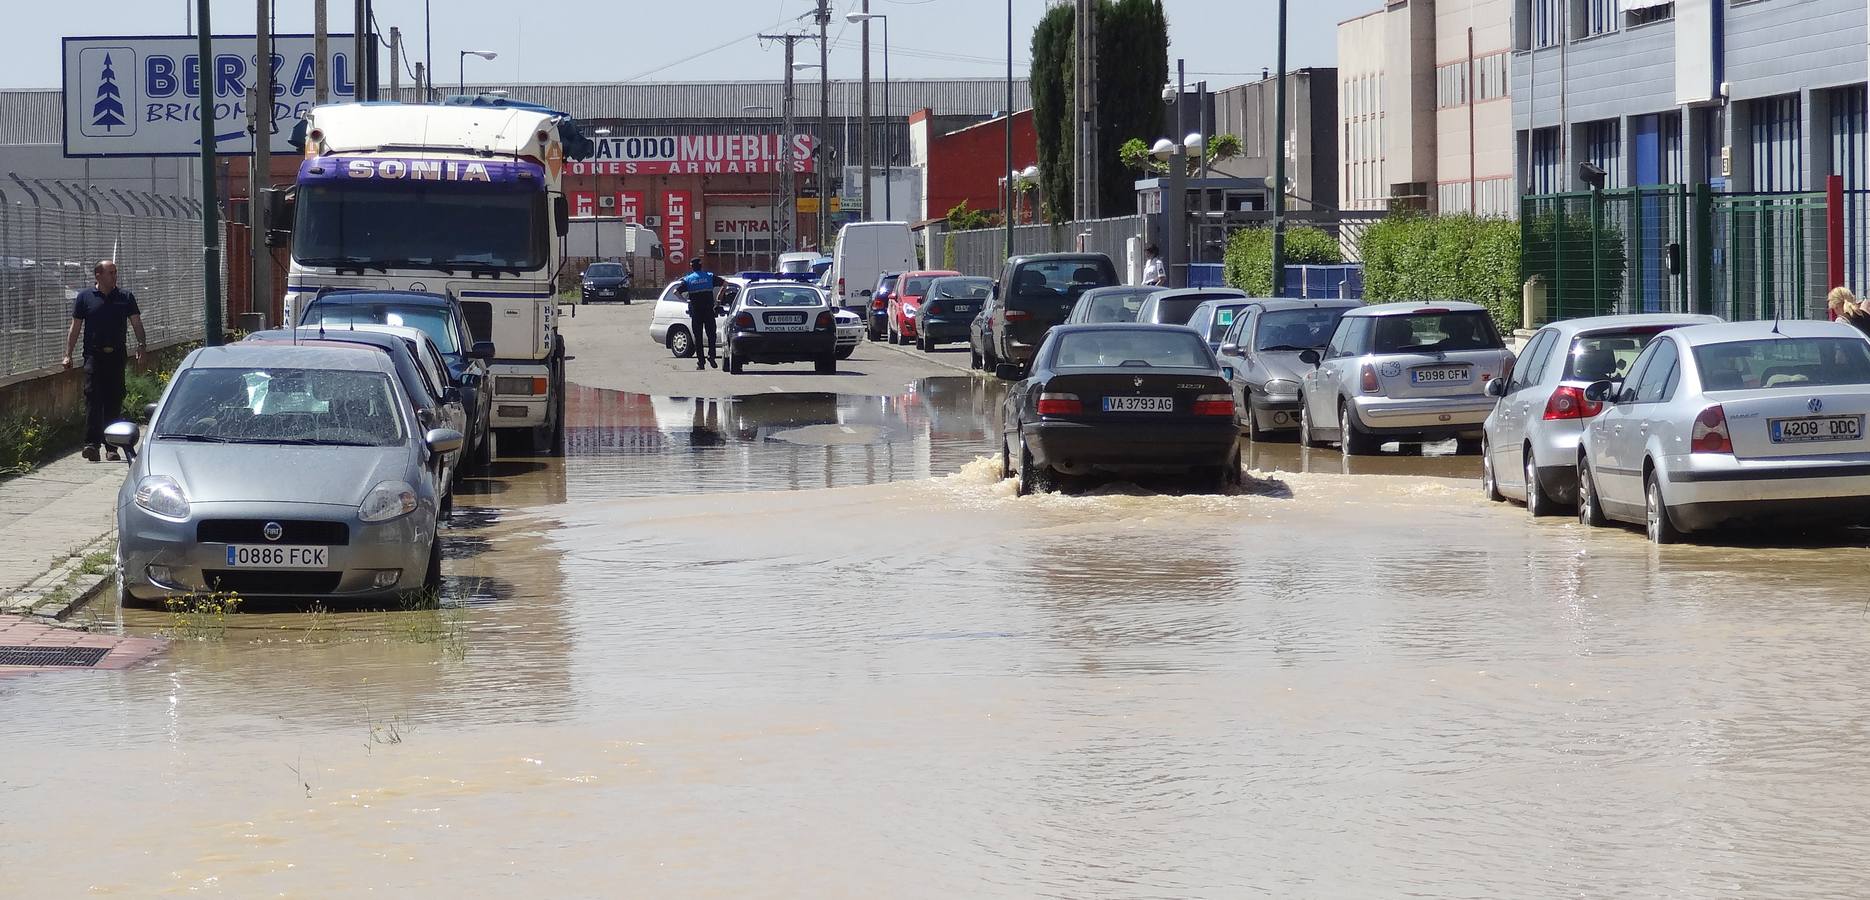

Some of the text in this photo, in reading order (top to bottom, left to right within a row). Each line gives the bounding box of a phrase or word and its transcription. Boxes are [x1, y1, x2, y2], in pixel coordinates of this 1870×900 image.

[145, 53, 355, 98] BERZAL
[349, 159, 491, 182] SONIA
[563, 162, 638, 174] ONES
[668, 193, 684, 264] OUTLET
[714, 220, 789, 232] ENTRA
[1418, 369, 1468, 381] 5098 CFM
[1110, 399, 1172, 410] VA 3793 AG
[1783, 420, 1856, 436] 4209 DDC
[239, 548, 324, 565] 0886 FCK
